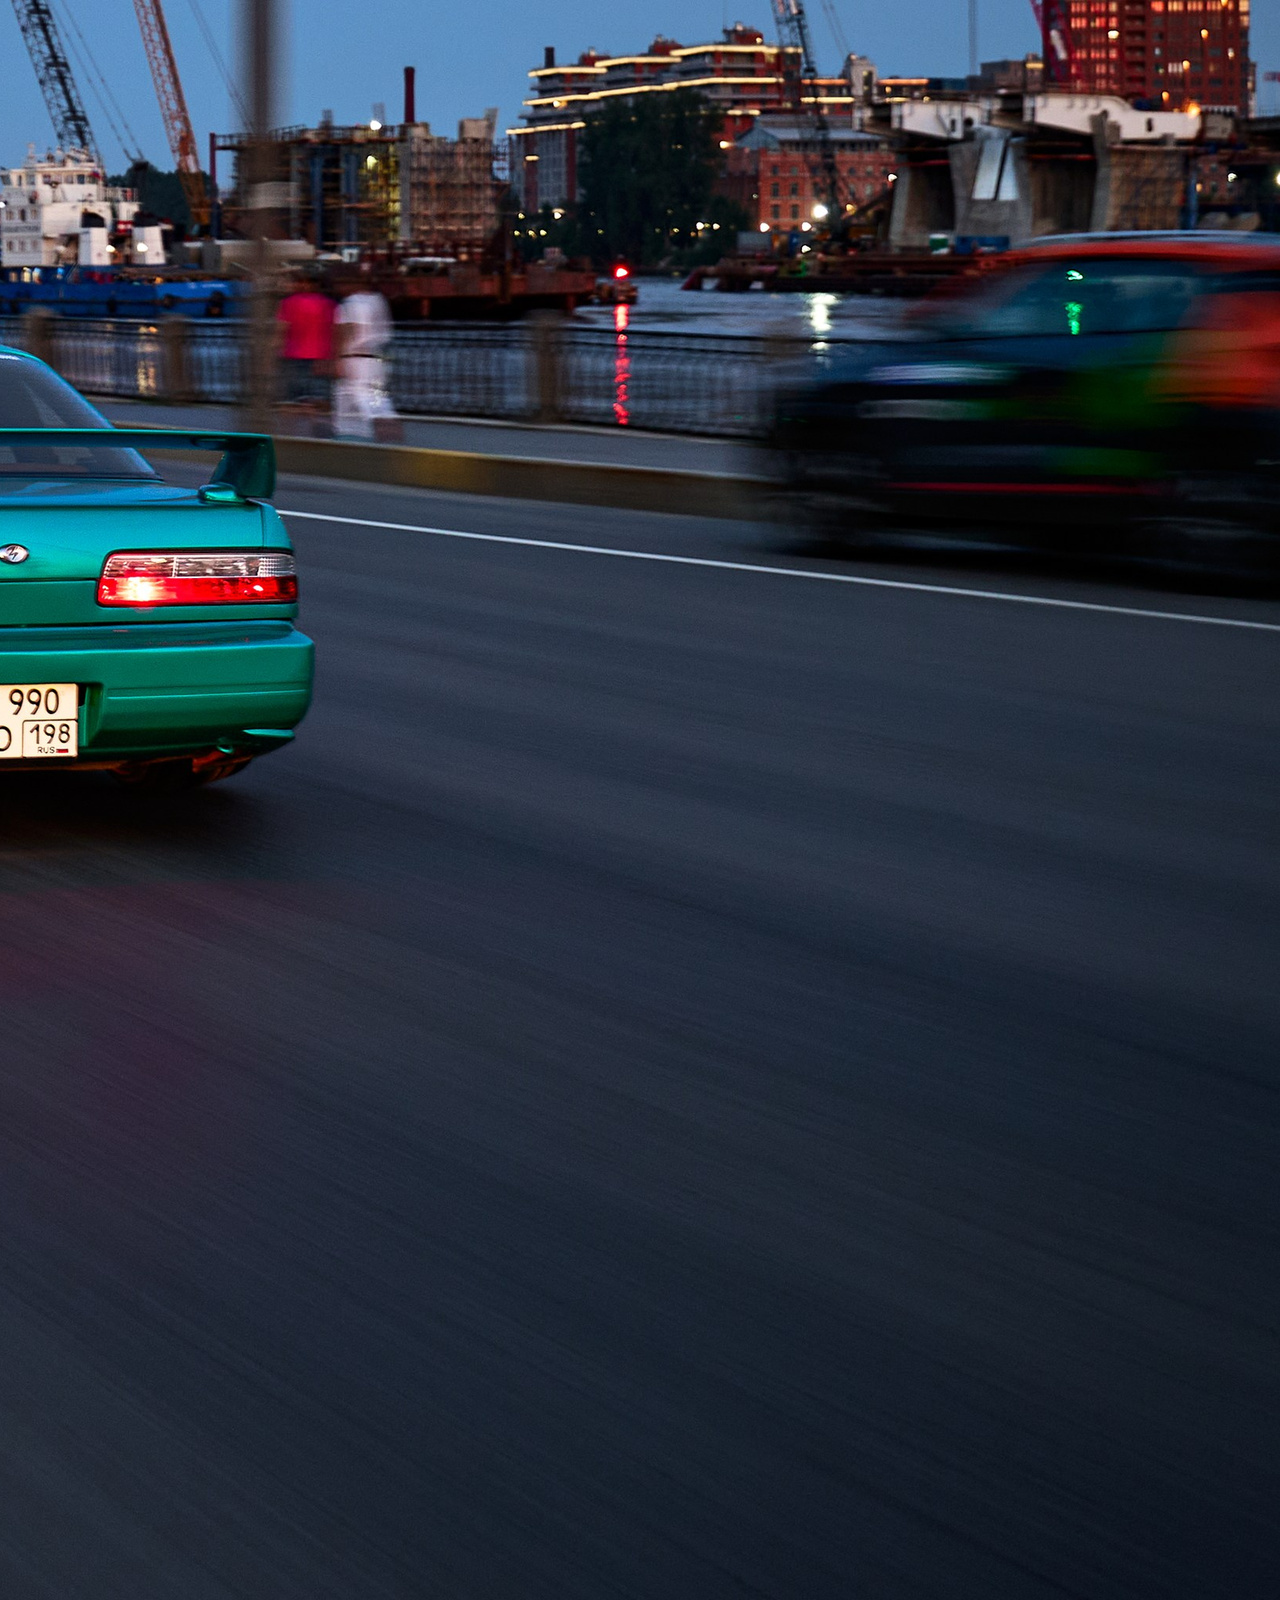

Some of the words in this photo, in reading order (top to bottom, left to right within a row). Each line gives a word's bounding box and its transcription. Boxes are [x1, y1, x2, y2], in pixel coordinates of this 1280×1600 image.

[9, 688, 60, 715] 990
[29, 723, 70, 744] 198
[37, 746, 55, 754] RUS
